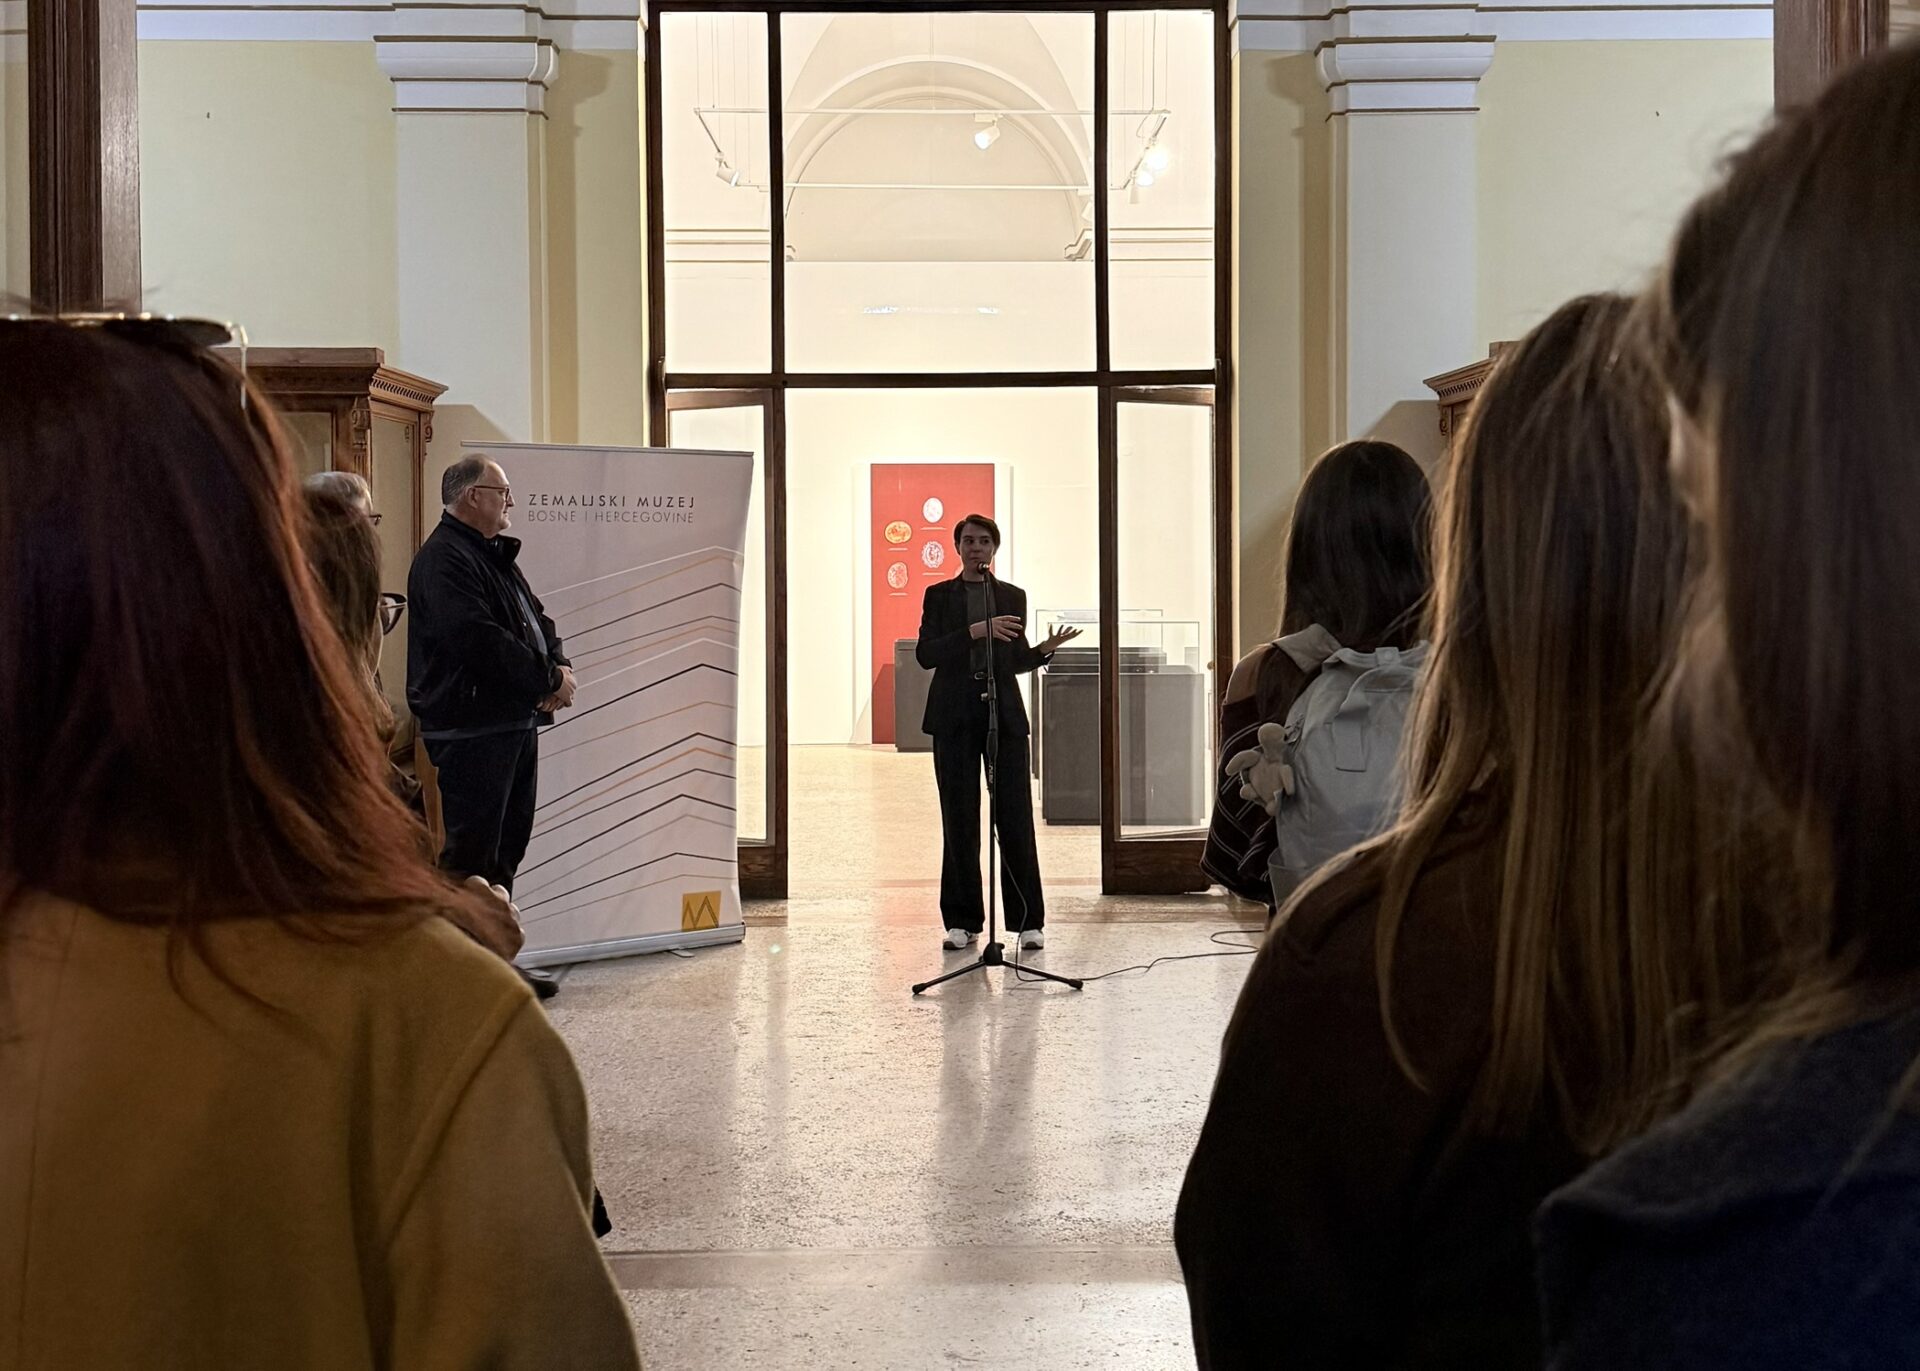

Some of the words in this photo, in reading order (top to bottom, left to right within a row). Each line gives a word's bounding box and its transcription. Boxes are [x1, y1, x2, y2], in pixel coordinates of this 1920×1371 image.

[528, 494, 625, 507] ZEMALJSKI
[636, 496, 695, 508] MUZEJ
[528, 510, 576, 522] BOSNE
[595, 511, 693, 523] HERCEGOVINE
